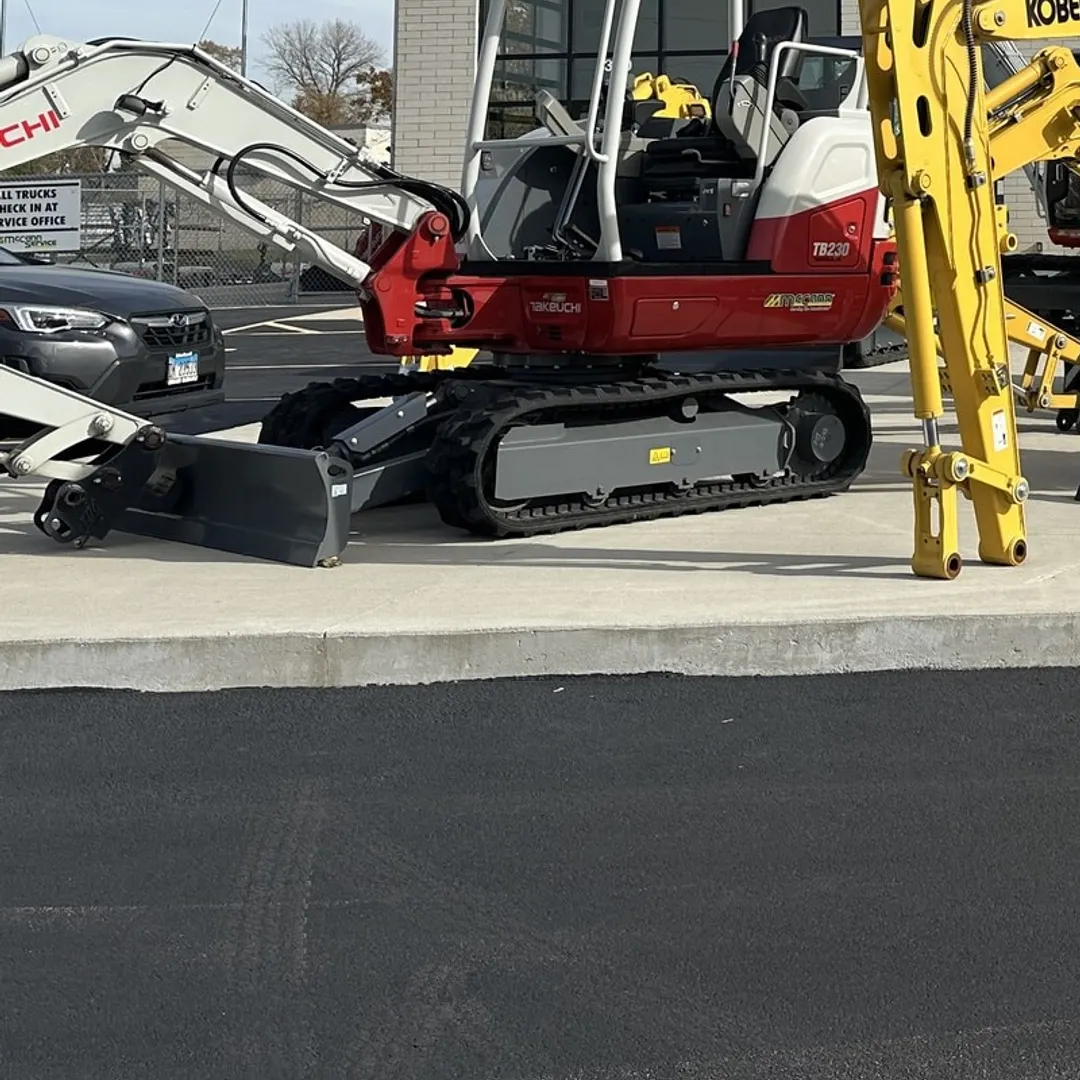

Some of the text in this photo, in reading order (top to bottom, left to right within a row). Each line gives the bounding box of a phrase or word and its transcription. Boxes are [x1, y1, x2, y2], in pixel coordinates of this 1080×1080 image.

[15, 189, 57, 200] TRUCKS
[29, 203, 42, 212] IN
[44, 202, 58, 212] AT
[31, 215, 66, 226] OFFICE
[813, 242, 850, 257] TB230
